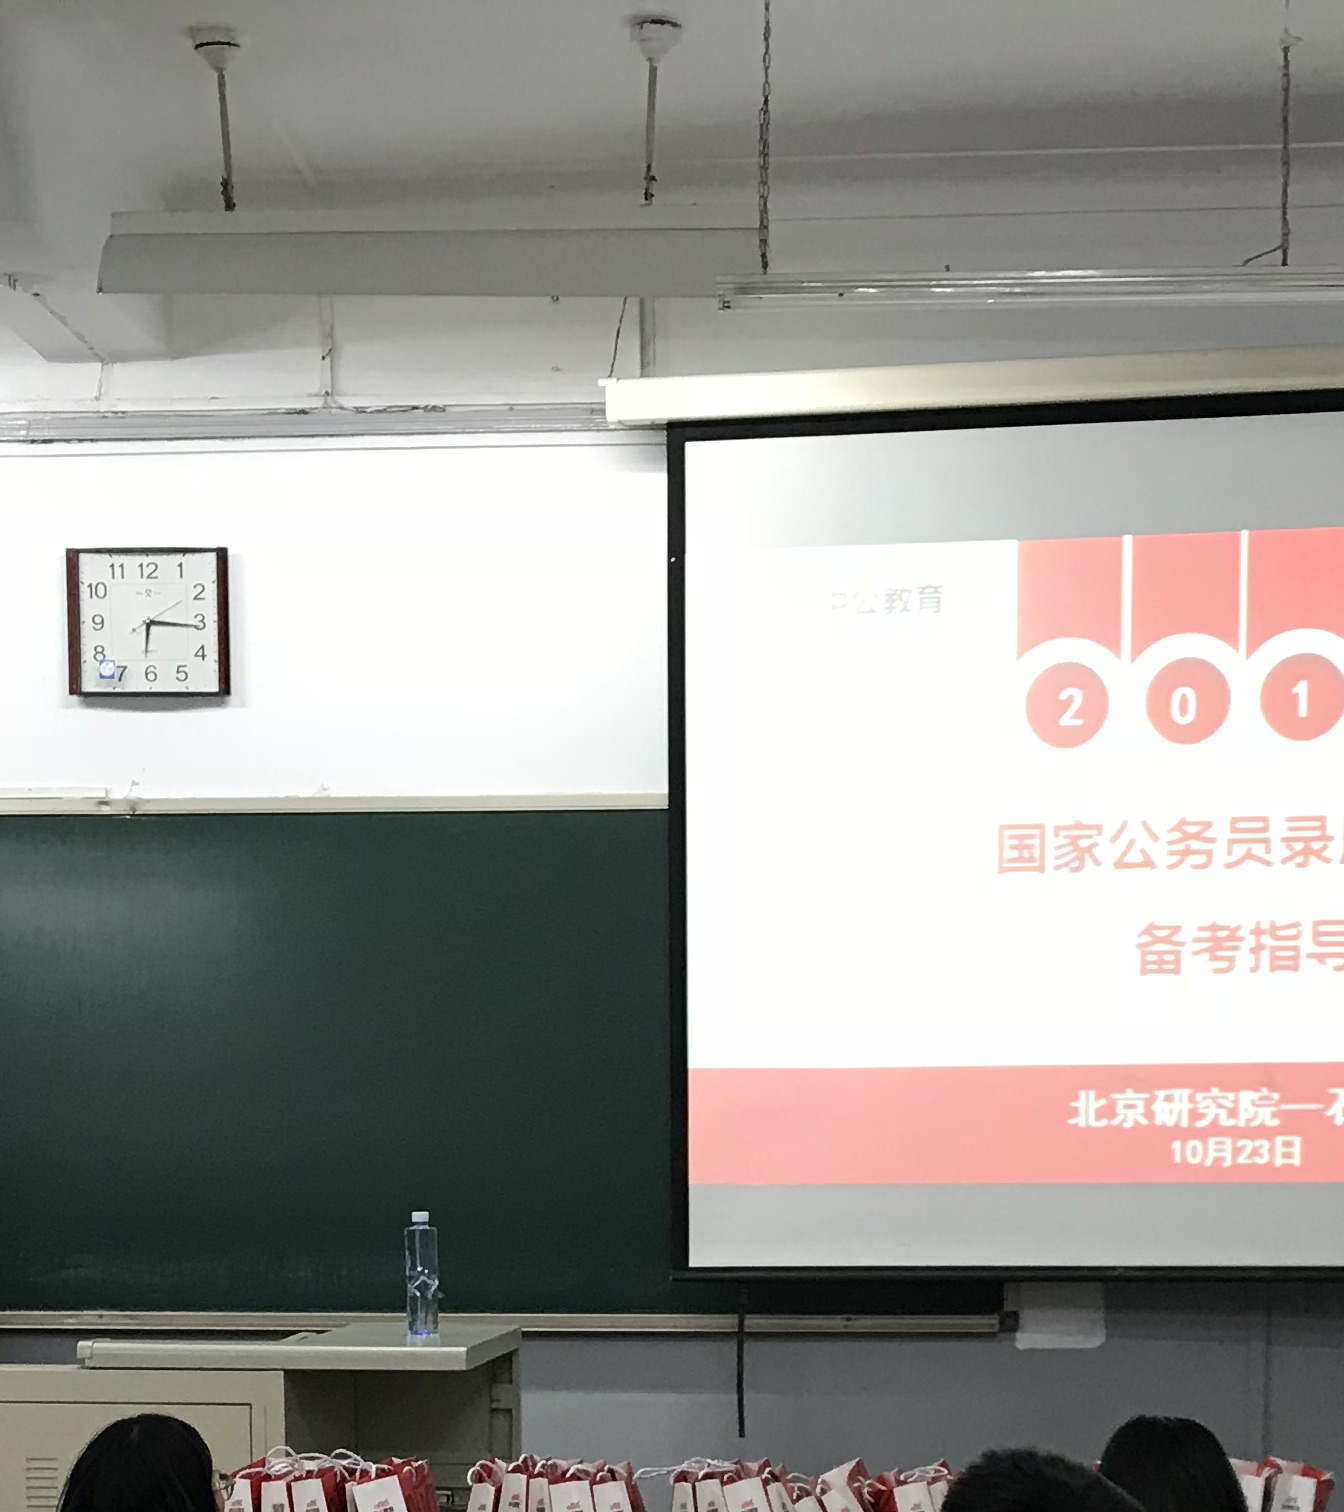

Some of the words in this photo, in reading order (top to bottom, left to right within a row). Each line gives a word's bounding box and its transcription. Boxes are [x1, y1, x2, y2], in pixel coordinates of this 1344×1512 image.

[109, 563, 125, 580] 11
[137, 562, 159, 580] 12
[177, 562, 184, 579] 1
[87, 582, 107, 600] 10
[193, 583, 206, 601] 2
[91, 613, 105, 631] 9
[193, 613, 207, 631] 3
[93, 645, 106, 662] 8
[194, 644, 207, 661] 4
[115, 665, 128, 682] 7
[145, 665, 158, 682] 6
[175, 664, 188, 682] 5
[1170, 1135, 1303, 1167] 10月23日
